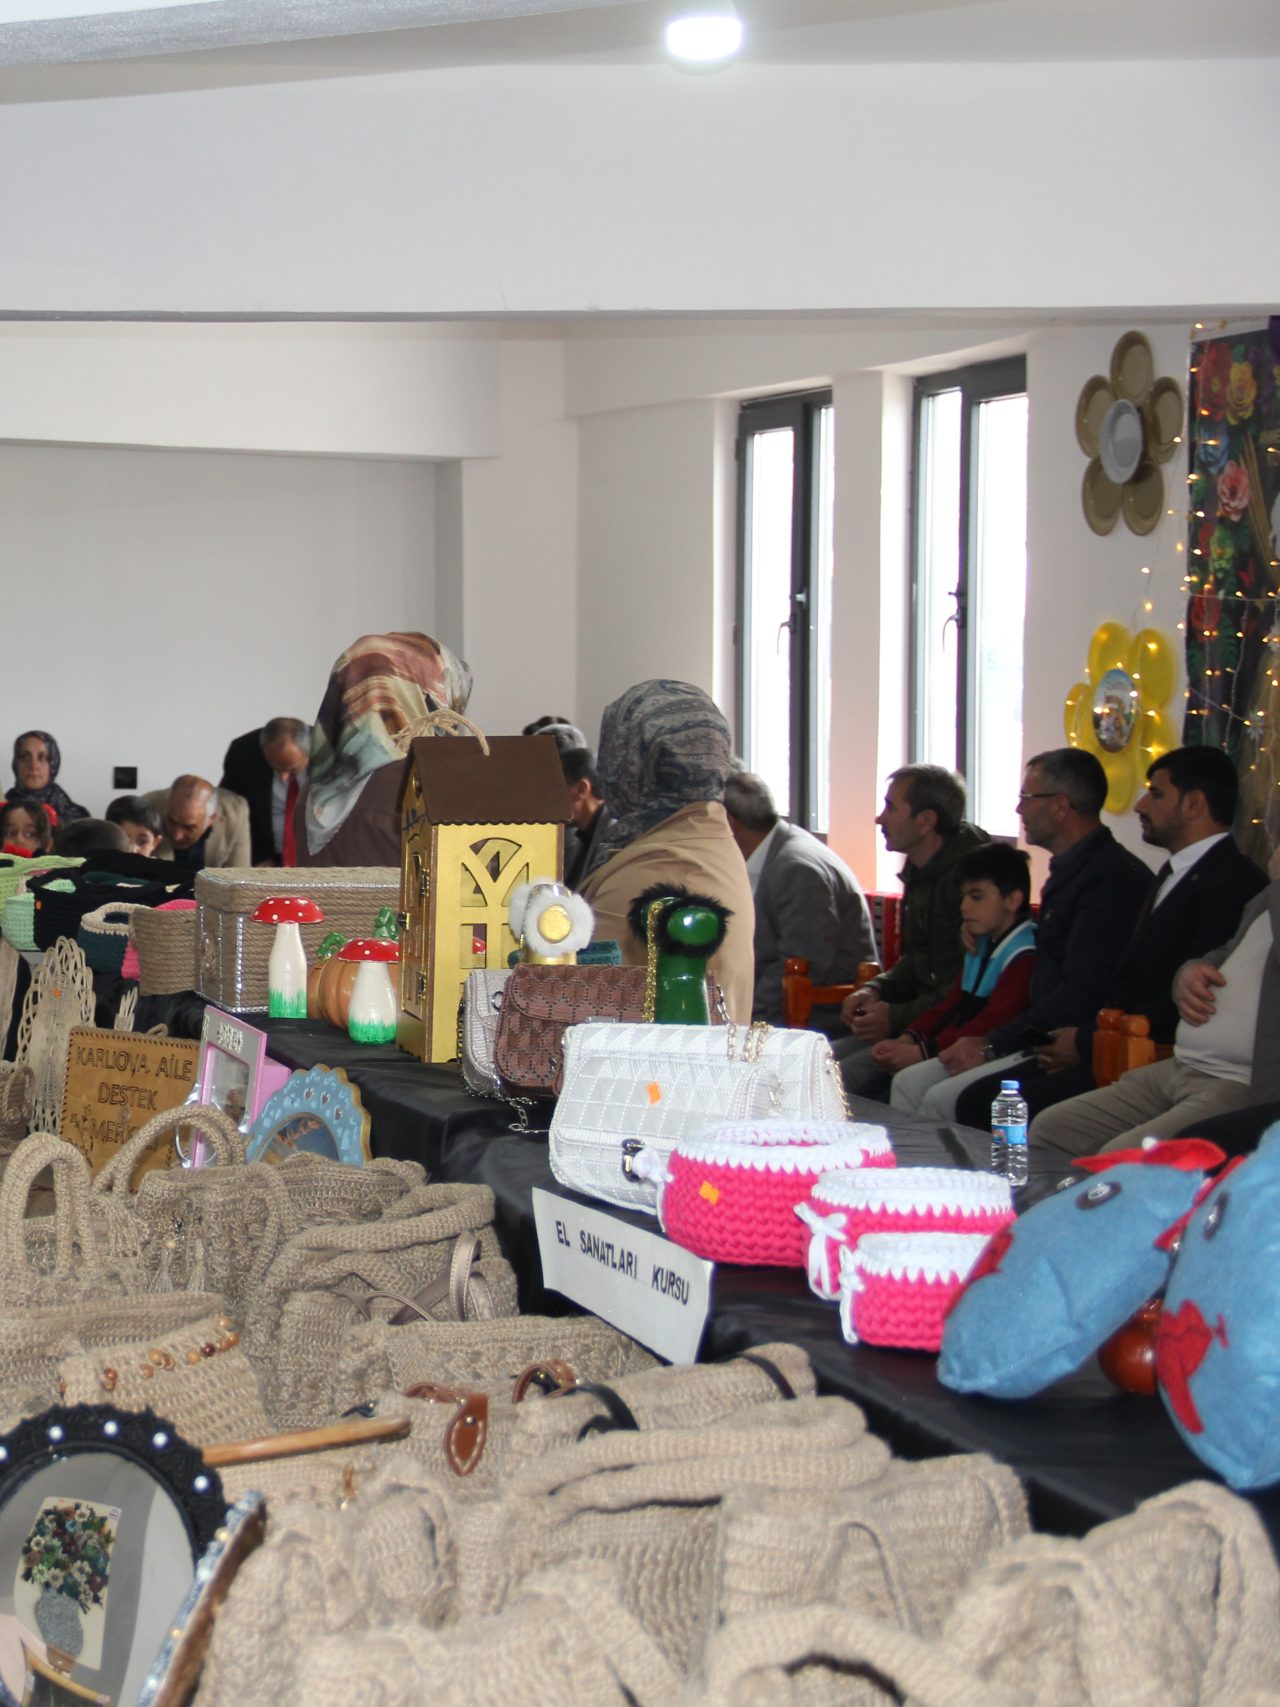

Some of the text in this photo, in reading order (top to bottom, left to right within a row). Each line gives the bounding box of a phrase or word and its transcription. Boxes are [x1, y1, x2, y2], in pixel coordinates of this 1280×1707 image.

[155, 1053, 193, 1082] AİLE
[97, 1081, 158, 1111] DESTEK
[555, 1220, 690, 1306] EL SANATLARI KURSU
